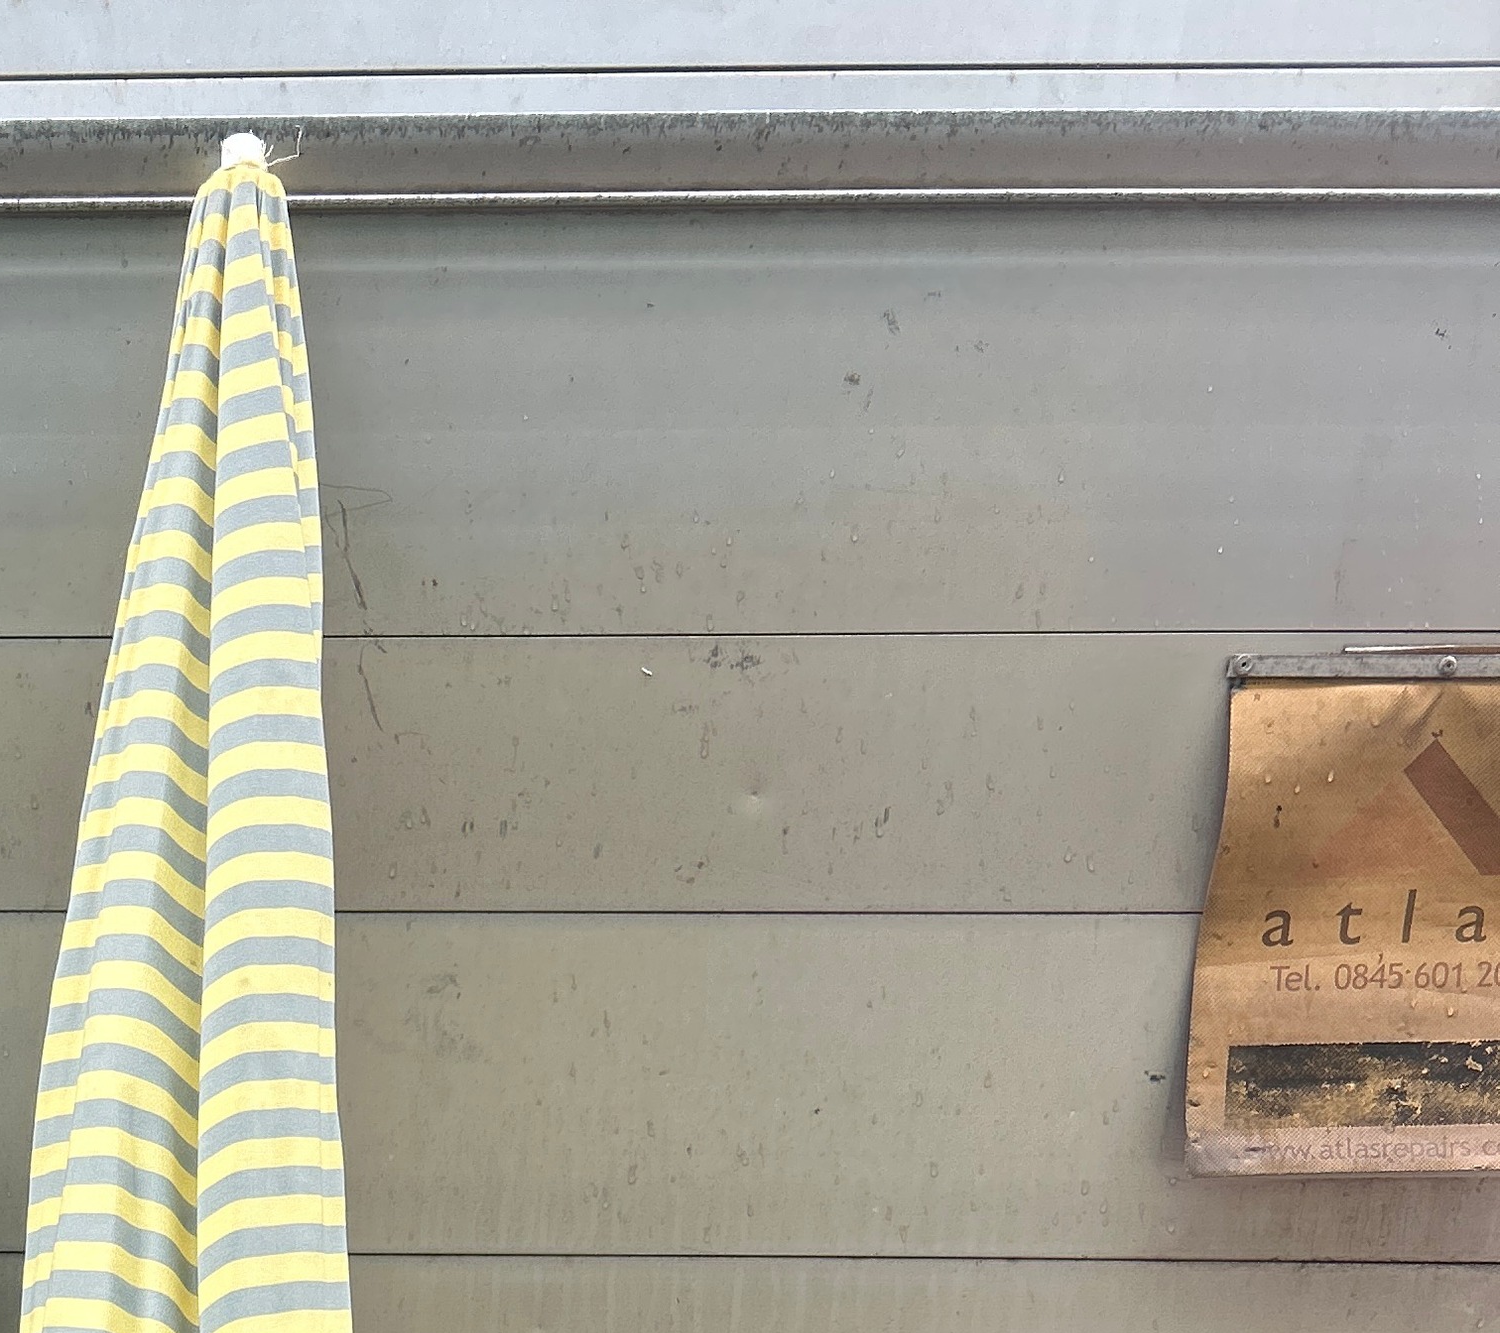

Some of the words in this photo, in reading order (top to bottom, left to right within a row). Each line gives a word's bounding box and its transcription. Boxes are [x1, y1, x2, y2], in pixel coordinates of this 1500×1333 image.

[1261, 888, 1488, 947] atla
[1269, 964, 1321, 992] Tel.
[1334, 961, 1404, 990] 0845
[1414, 961, 1462, 989] 601
